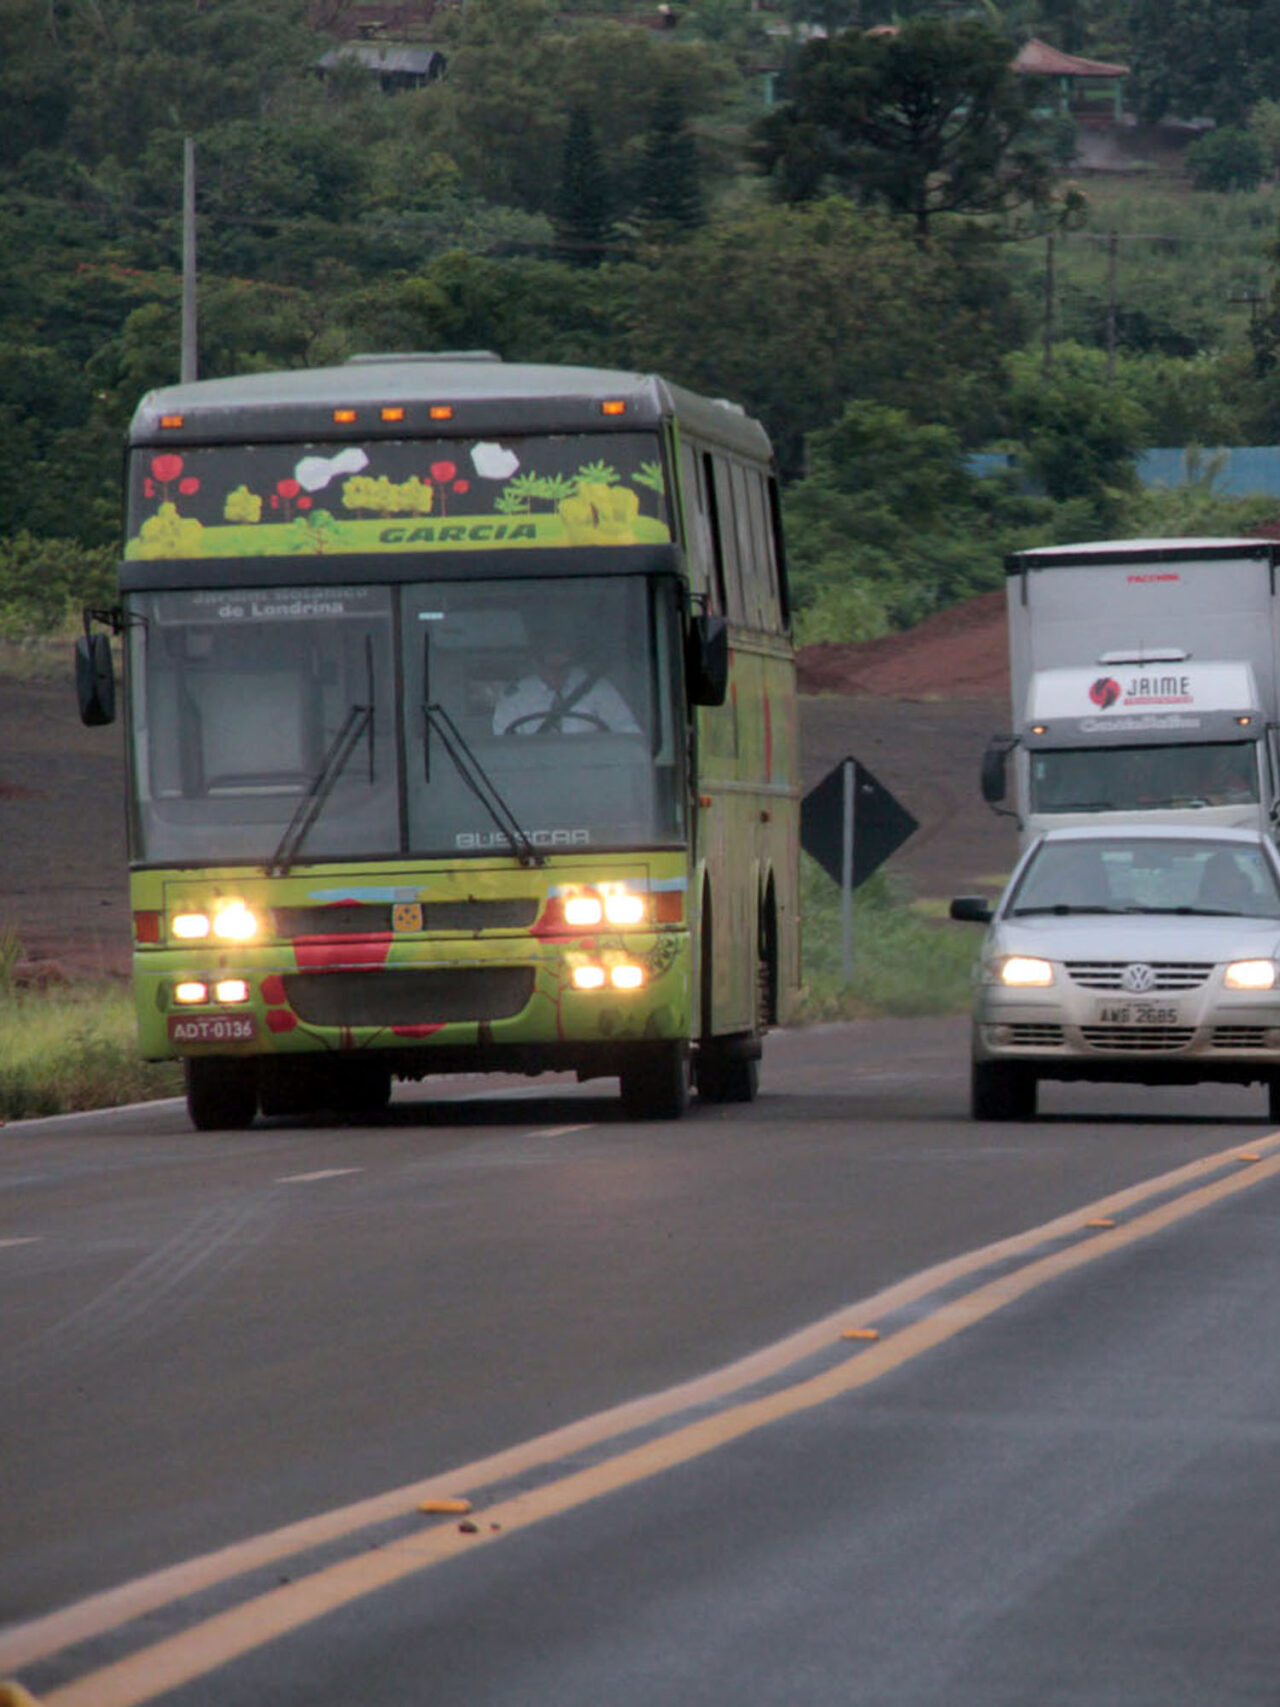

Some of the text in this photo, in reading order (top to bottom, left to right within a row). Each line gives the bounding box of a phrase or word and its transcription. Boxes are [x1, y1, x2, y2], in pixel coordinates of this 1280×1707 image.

[379, 523, 537, 544] GARCIA
[218, 601, 344, 618] de Londrina
[1126, 676, 1190, 696] JAIME
[455, 829, 590, 849] BUSSCAR
[174, 1021, 253, 1038] ADT-0136
